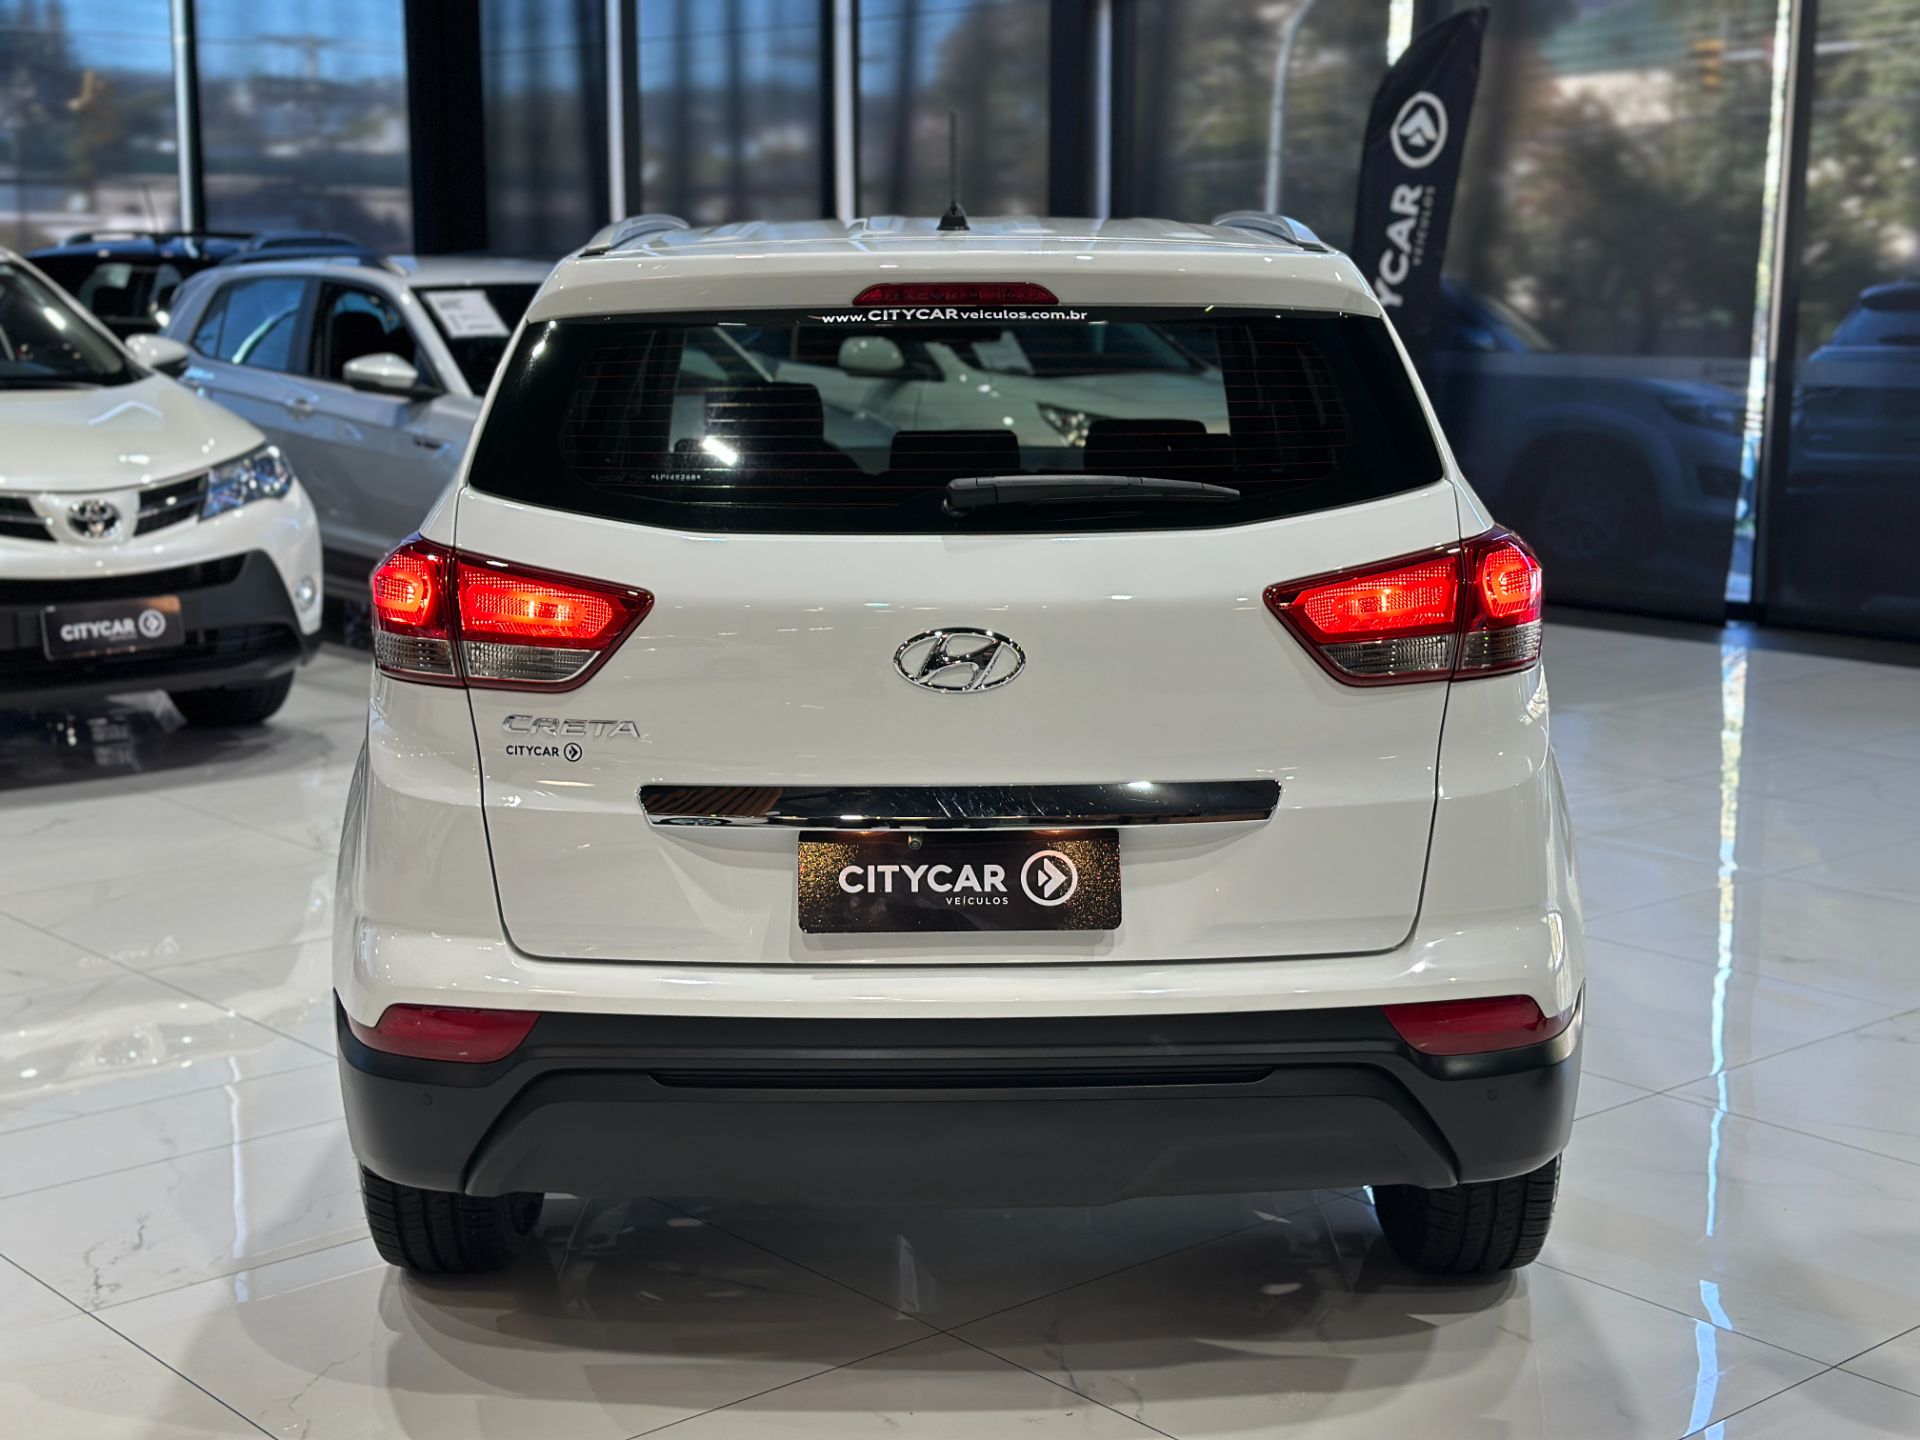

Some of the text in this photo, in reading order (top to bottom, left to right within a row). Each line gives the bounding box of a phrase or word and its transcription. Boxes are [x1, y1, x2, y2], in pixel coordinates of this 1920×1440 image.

[60, 617, 136, 641] CITYCAR
[502, 714, 641, 738] CRETA
[505, 744, 560, 757] CITYCAR
[838, 864, 1008, 893] CITYCAR
[945, 895, 1009, 906] VEÍCULOS
